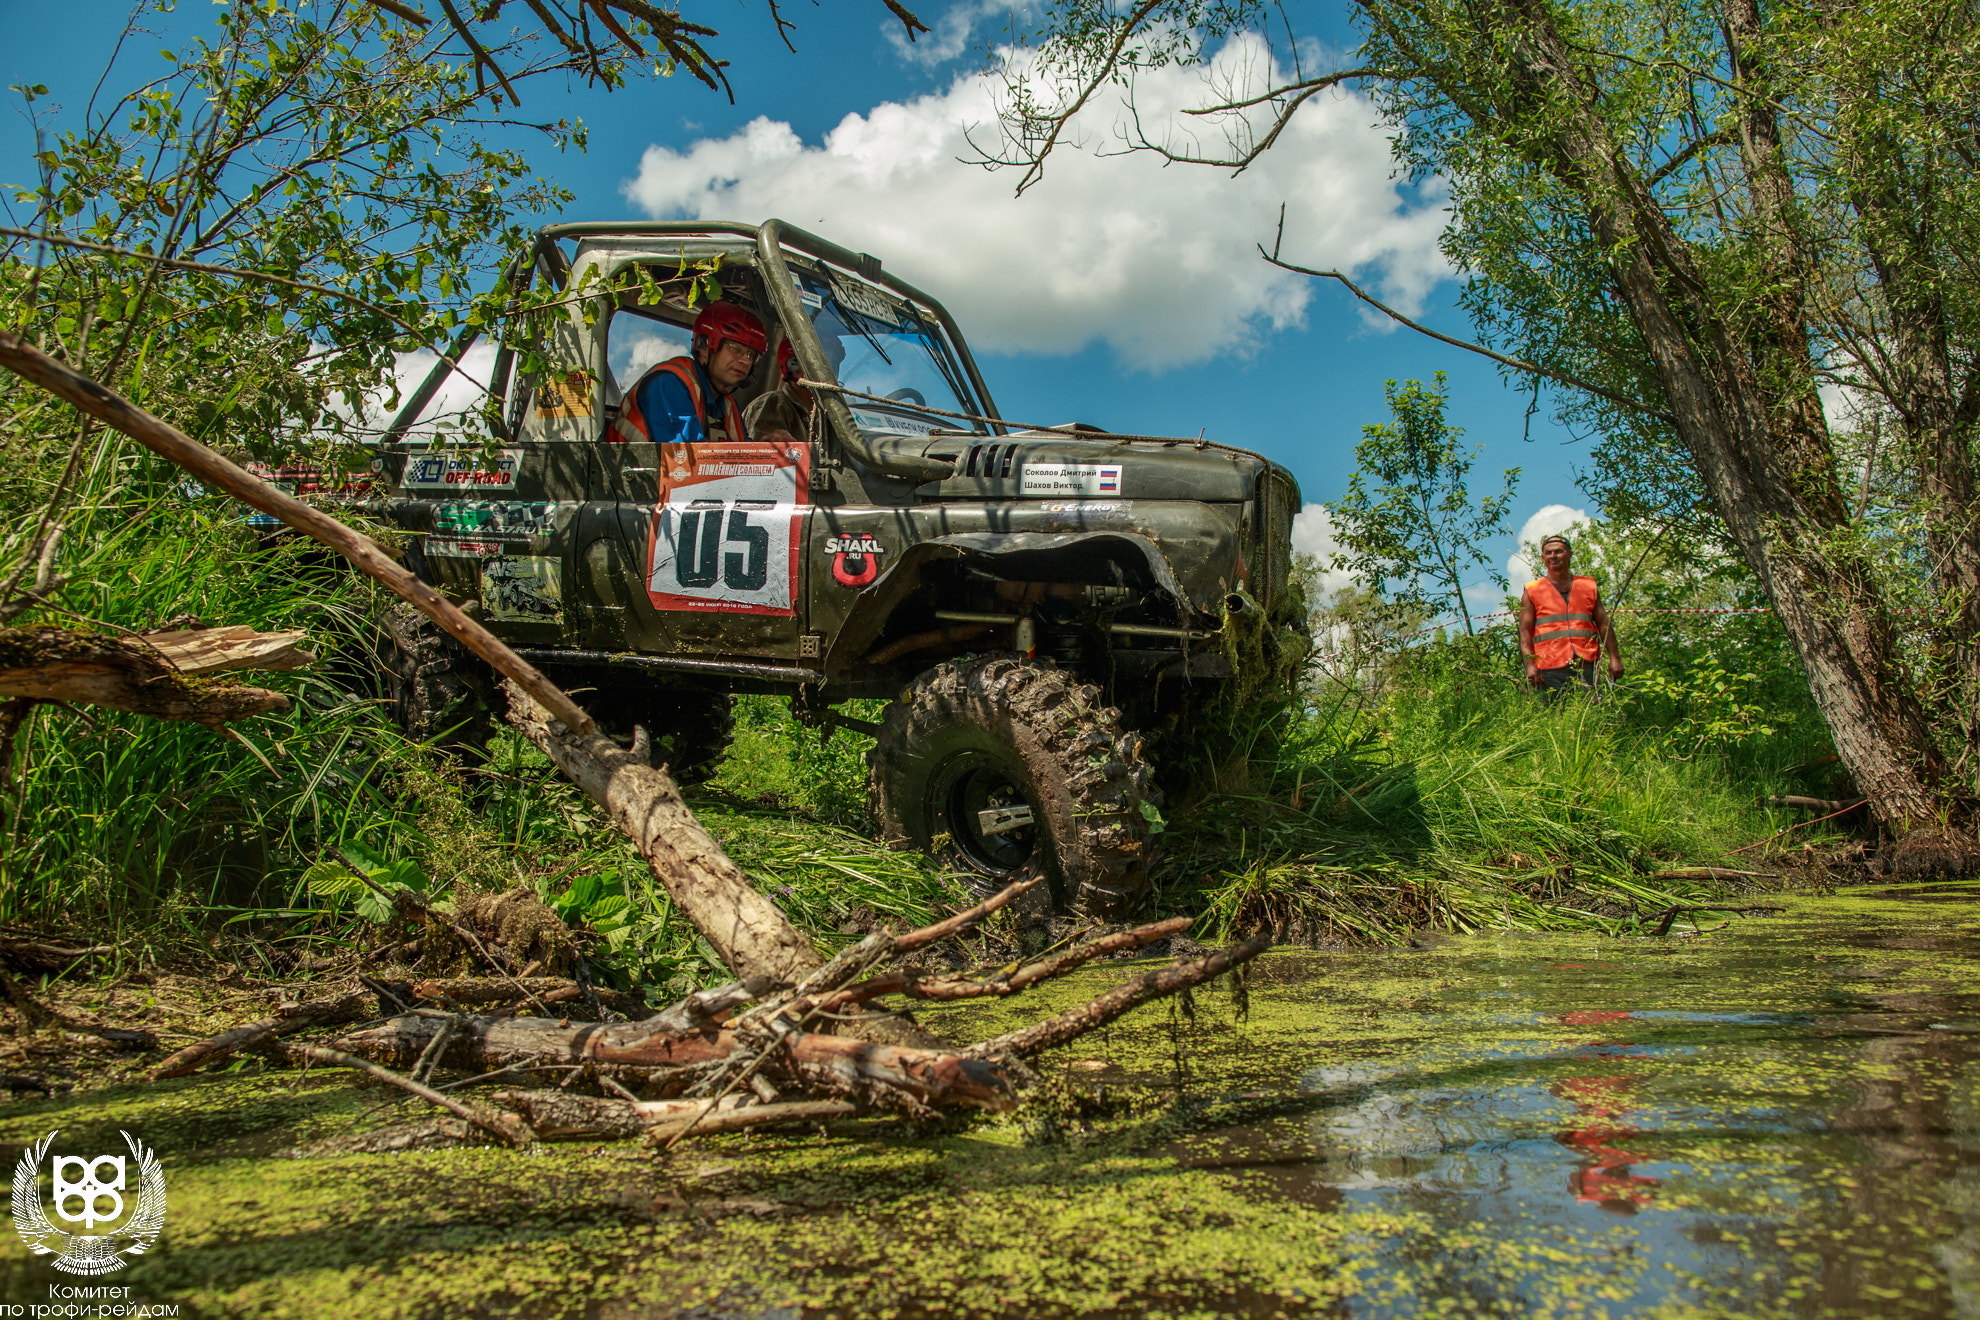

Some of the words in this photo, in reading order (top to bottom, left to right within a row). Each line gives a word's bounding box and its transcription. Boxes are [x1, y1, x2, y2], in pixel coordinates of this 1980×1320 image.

[445, 471, 511, 484] OFF-ROAD
[1060, 469, 1097, 477] Дмитрий
[1053, 482, 1083, 490] Виктор
[676, 499, 777, 591] 05
[824, 538, 884, 553] SHAKL
[486, 561, 517, 577] AVS
